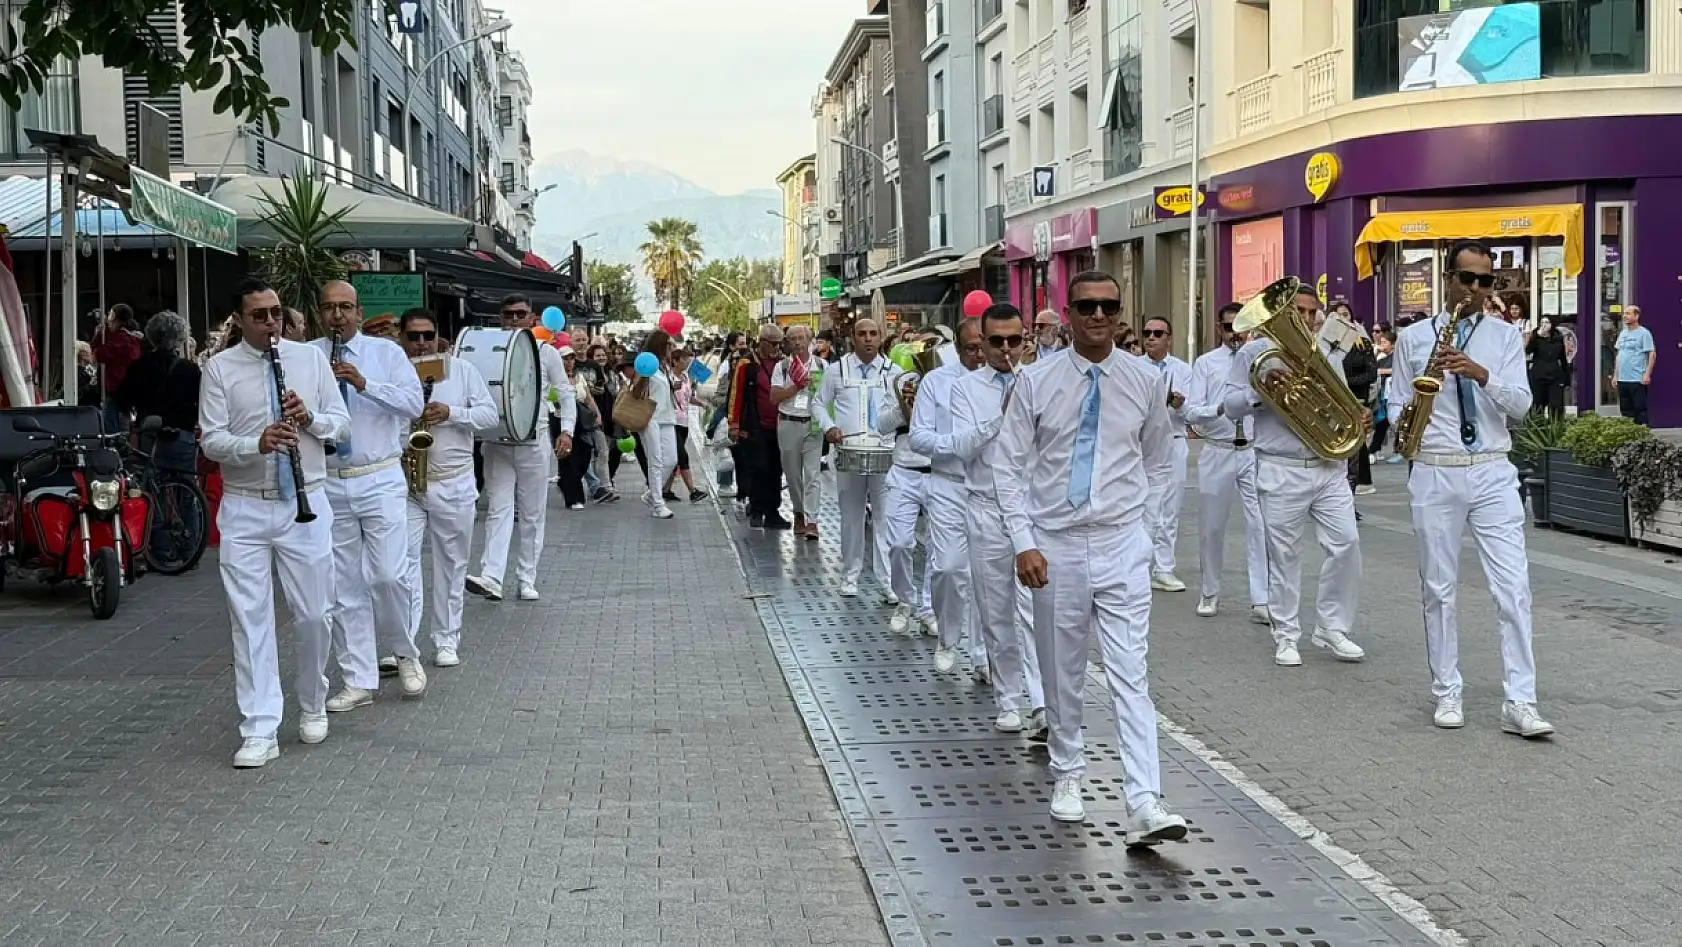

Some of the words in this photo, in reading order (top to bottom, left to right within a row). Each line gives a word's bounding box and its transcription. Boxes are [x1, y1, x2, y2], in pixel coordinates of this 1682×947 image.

[1308, 159, 1329, 187] gratis
[1162, 188, 1199, 206] grati
[1400, 220, 1430, 234] gratis
[1500, 215, 1532, 229] gratis
